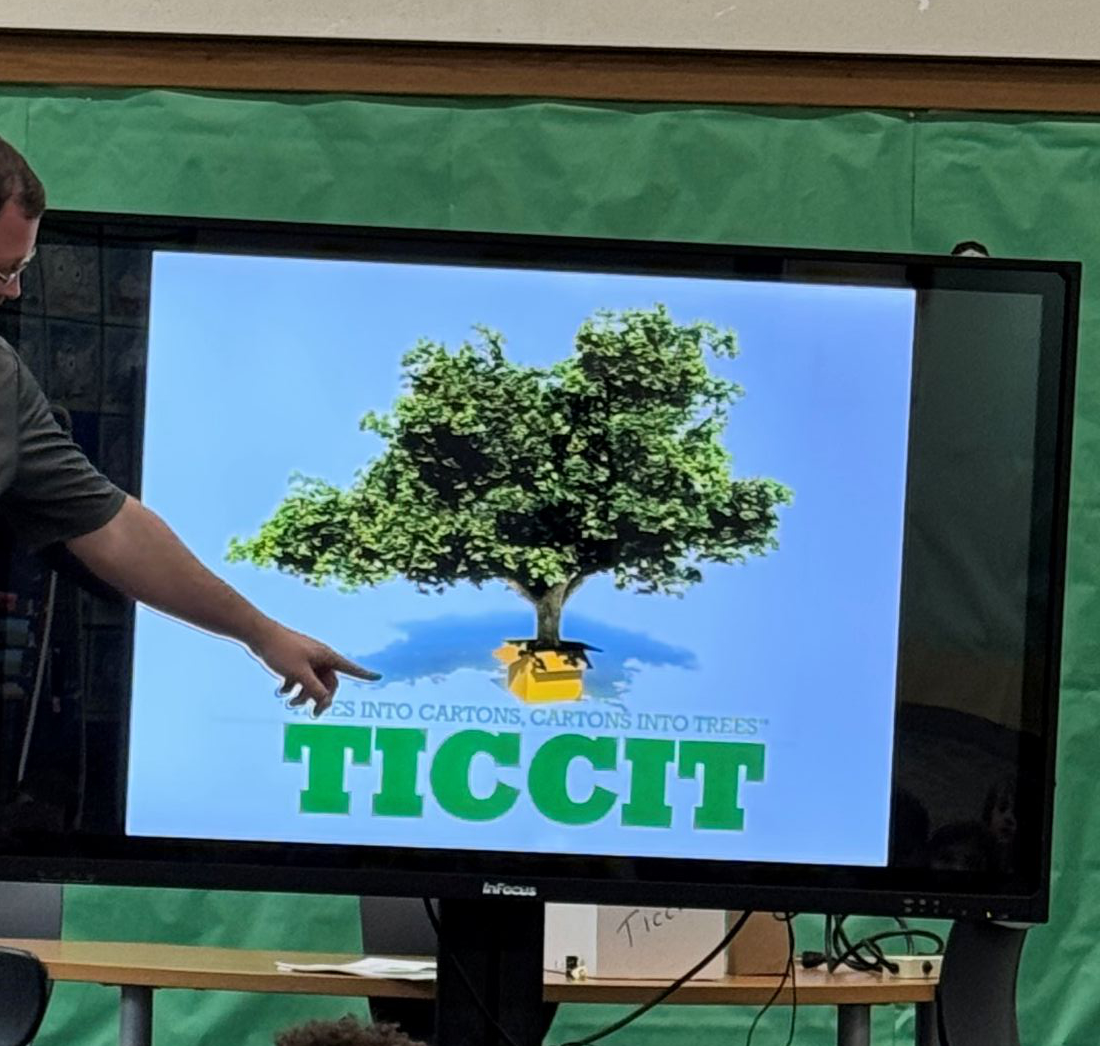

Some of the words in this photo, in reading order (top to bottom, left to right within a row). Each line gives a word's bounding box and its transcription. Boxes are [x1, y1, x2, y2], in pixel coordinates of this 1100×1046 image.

[360, 700, 412, 721] INTO
[418, 703, 526, 727] CARTONS,
[530, 708, 631, 730] CARTONS
[637, 713, 688, 732] INTO
[283, 723, 765, 831] TICCIT
